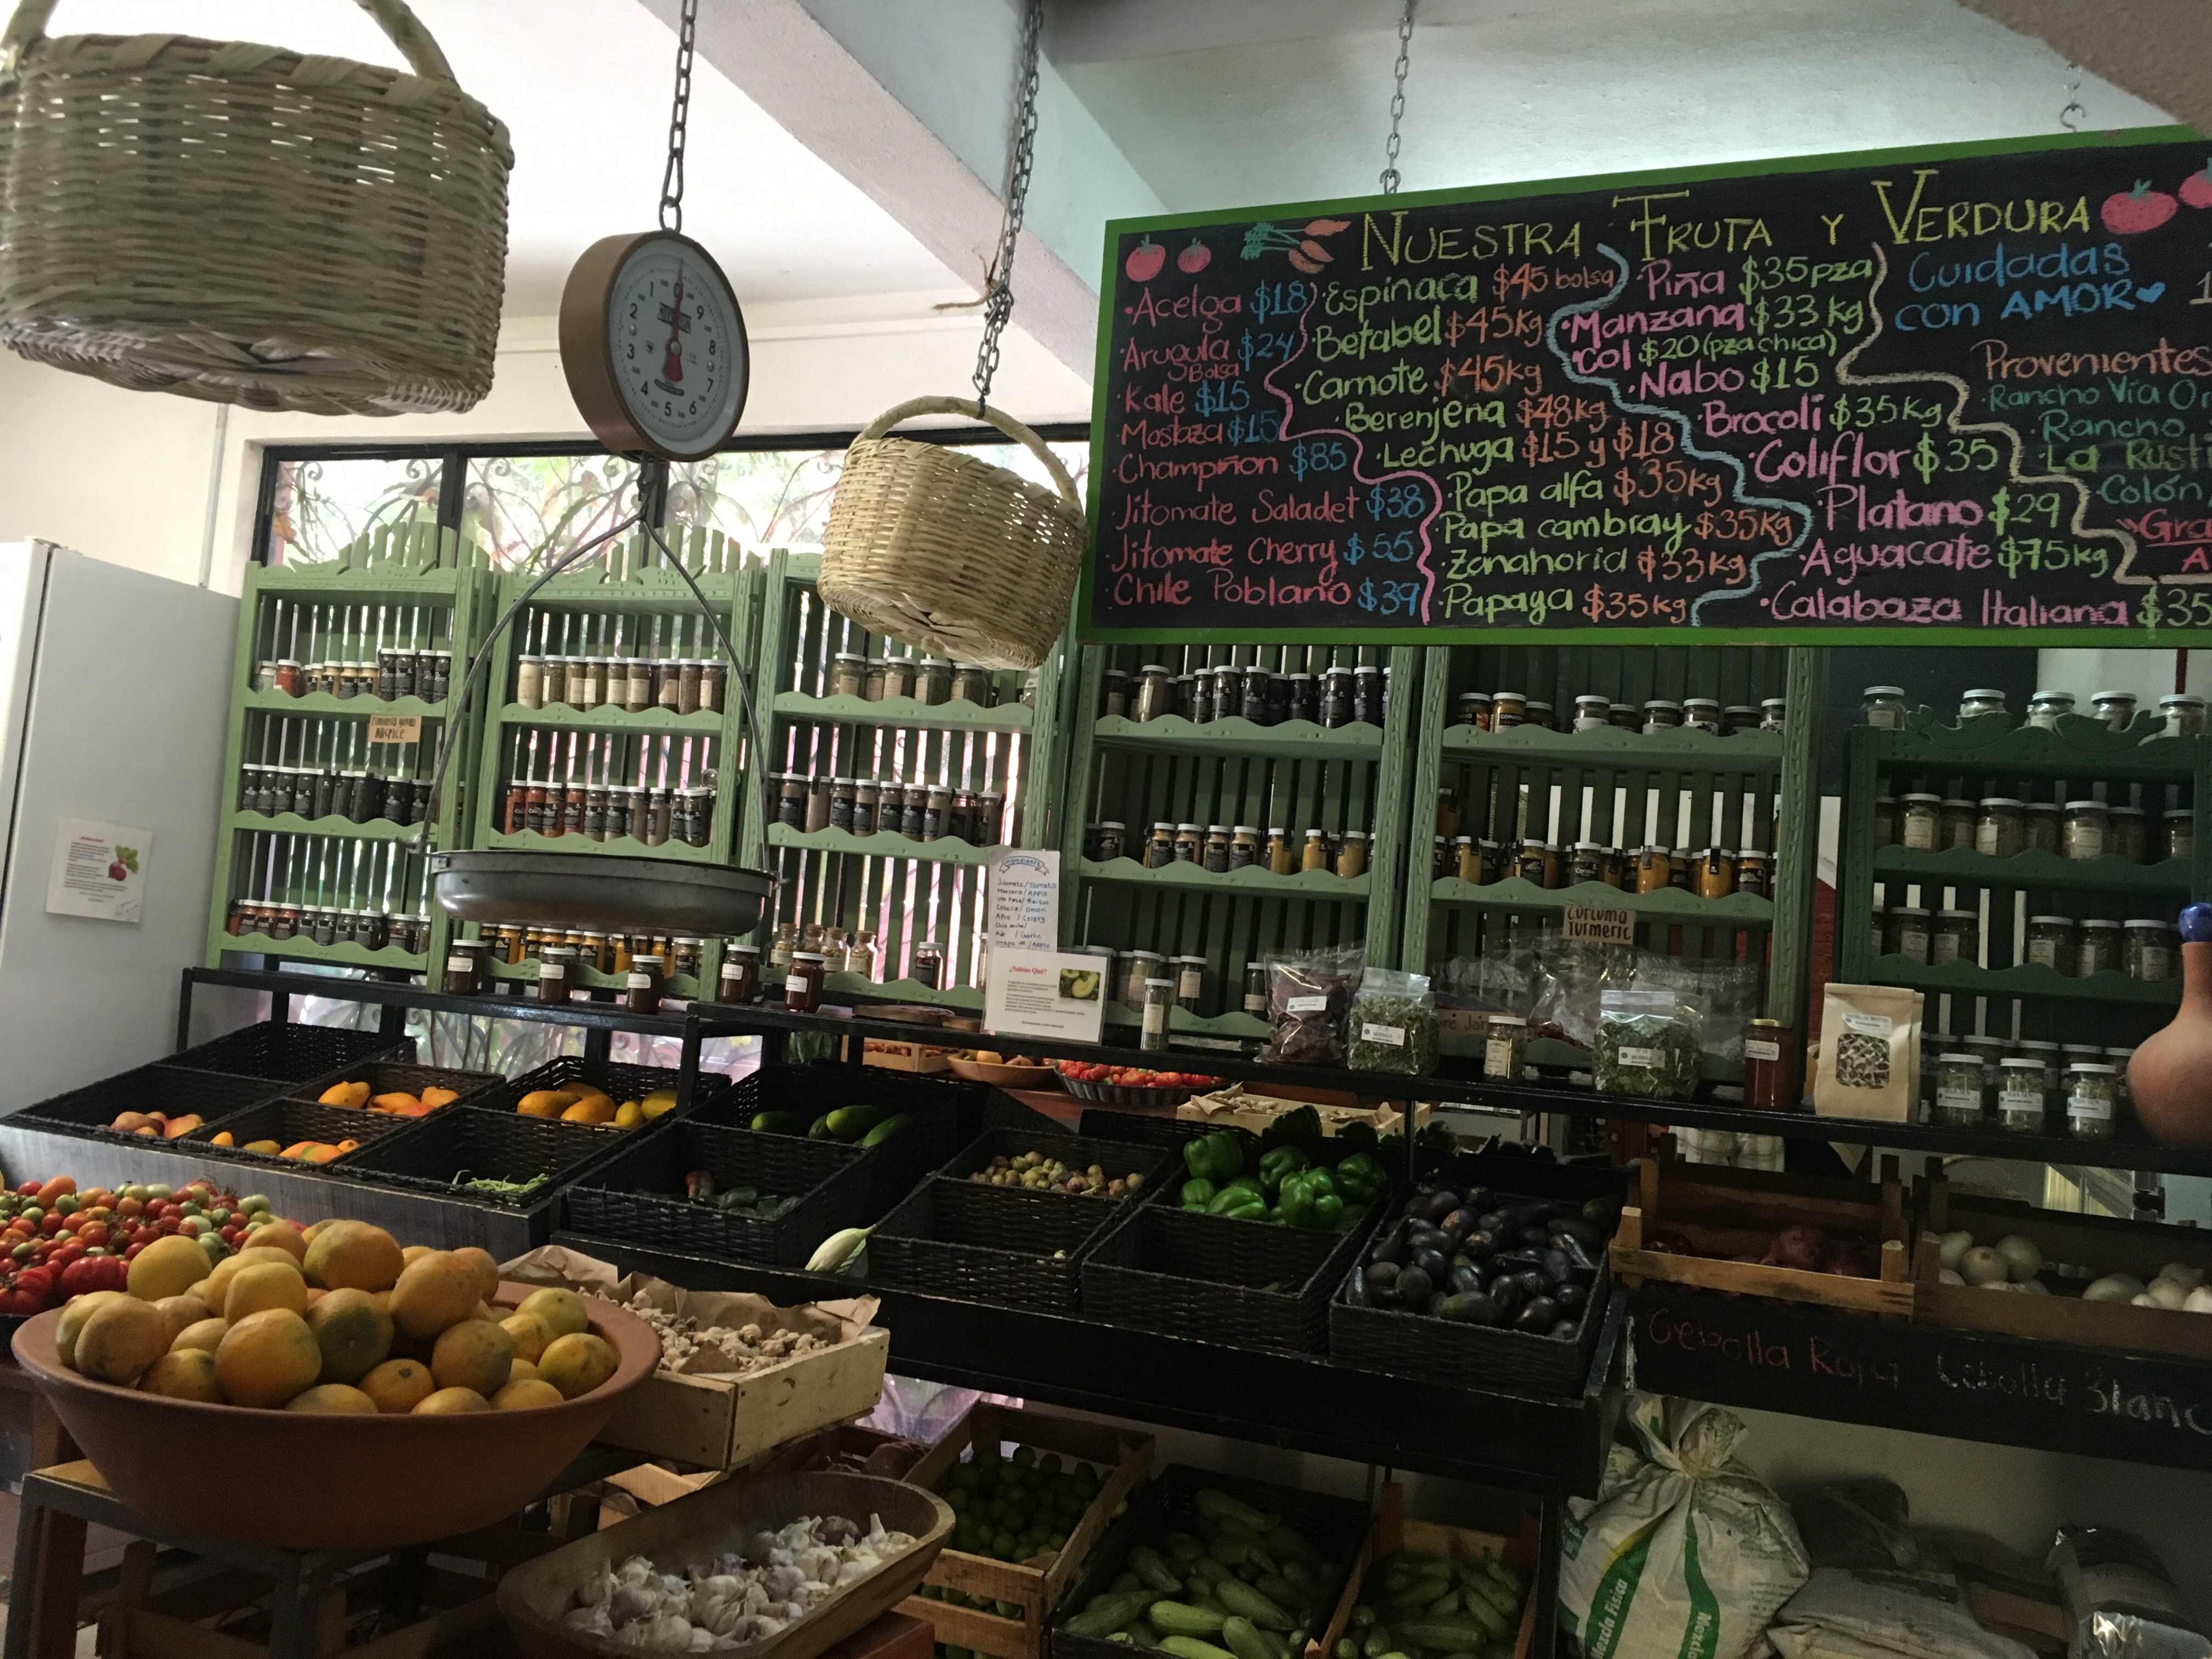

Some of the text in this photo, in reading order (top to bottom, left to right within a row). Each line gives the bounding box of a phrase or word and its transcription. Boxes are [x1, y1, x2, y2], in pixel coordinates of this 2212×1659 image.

[1361, 169, 2090, 270] NUESTRA FRUTA Y VERDURA
[650, 281, 653, 297] 1
[1640, 258, 1726, 300] Piña
[1908, 241, 2131, 293] Cuidadas
[630, 303, 637, 320] 2
[697, 304, 704, 320] 9
[1132, 279, 1308, 333] Acelga $18
[1325, 263, 1614, 323] Espinaca $45 bolsa
[1895, 279, 2135, 331] con AMOR
[1316, 304, 1442, 362] Betabel
[1570, 302, 1745, 349] Manzana
[1750, 295, 1820, 335] $33
[627, 343, 635, 360] 3
[709, 340, 716, 355] 8
[1124, 328, 1294, 381] Arugula $24
[1575, 338, 1632, 374] Col
[1638, 335, 1699, 366] $20
[1970, 336, 2212, 380] Provenientes
[641, 381, 648, 396] 4
[707, 377, 713, 392] 7
[1189, 363, 1239, 382] Bolsa
[1303, 358, 1428, 405] Camote
[1641, 355, 1819, 400] Nabo $15
[664, 401, 672, 416] 5
[690, 400, 696, 415] 6
[1125, 379, 1250, 416] Kale $15
[1345, 396, 1506, 443] Berenjena
[1703, 393, 1825, 438] Brocoli
[1989, 384, 2100, 411] Rancho
[1122, 409, 1279, 449] Mostaza $15
[1383, 420, 1675, 475] Lechuga $15 y $18
[2038, 409, 2186, 442] Rancho
[1289, 441, 1347, 481] $85
[1755, 431, 1999, 486] Coliflor $35
[2048, 444, 2099, 473] La
[1116, 482, 1425, 531] Jitomate Saladet $38
[1446, 471, 1528, 517] Papa
[1539, 470, 1604, 509] alfa
[1816, 484, 2060, 537] Platano $29
[2101, 474, 2203, 504] Colón
[1439, 511, 1525, 553] Papa
[1537, 509, 1692, 555] cambray
[1111, 529, 1414, 585] Jitomate Cherry $55
[1802, 532, 1993, 585] Aguacate
[1114, 568, 1420, 616] Chile Poblano $39
[1442, 583, 1574, 625] Papaya
[1771, 580, 1962, 622] Calabaza
[1982, 589, 2129, 627] Italiana
[1023, 915, 1045, 923] Celery
[1649, 1307, 1899, 1389] Cebolla Roja
